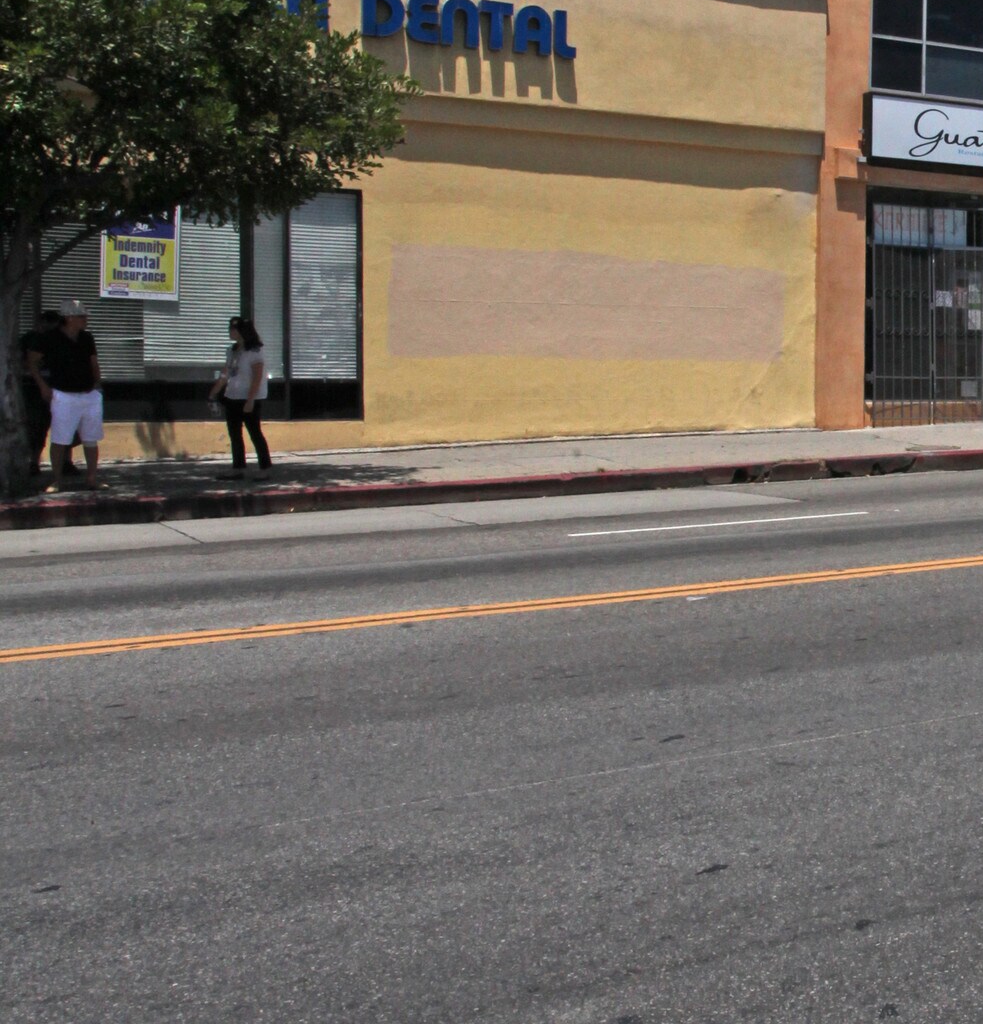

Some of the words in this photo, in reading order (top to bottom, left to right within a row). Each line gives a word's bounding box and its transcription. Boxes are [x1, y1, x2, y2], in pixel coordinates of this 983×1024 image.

[113, 239, 166, 256] Indemnity
[119, 254, 160, 270] Dental
[112, 268, 166, 283] Insurance
